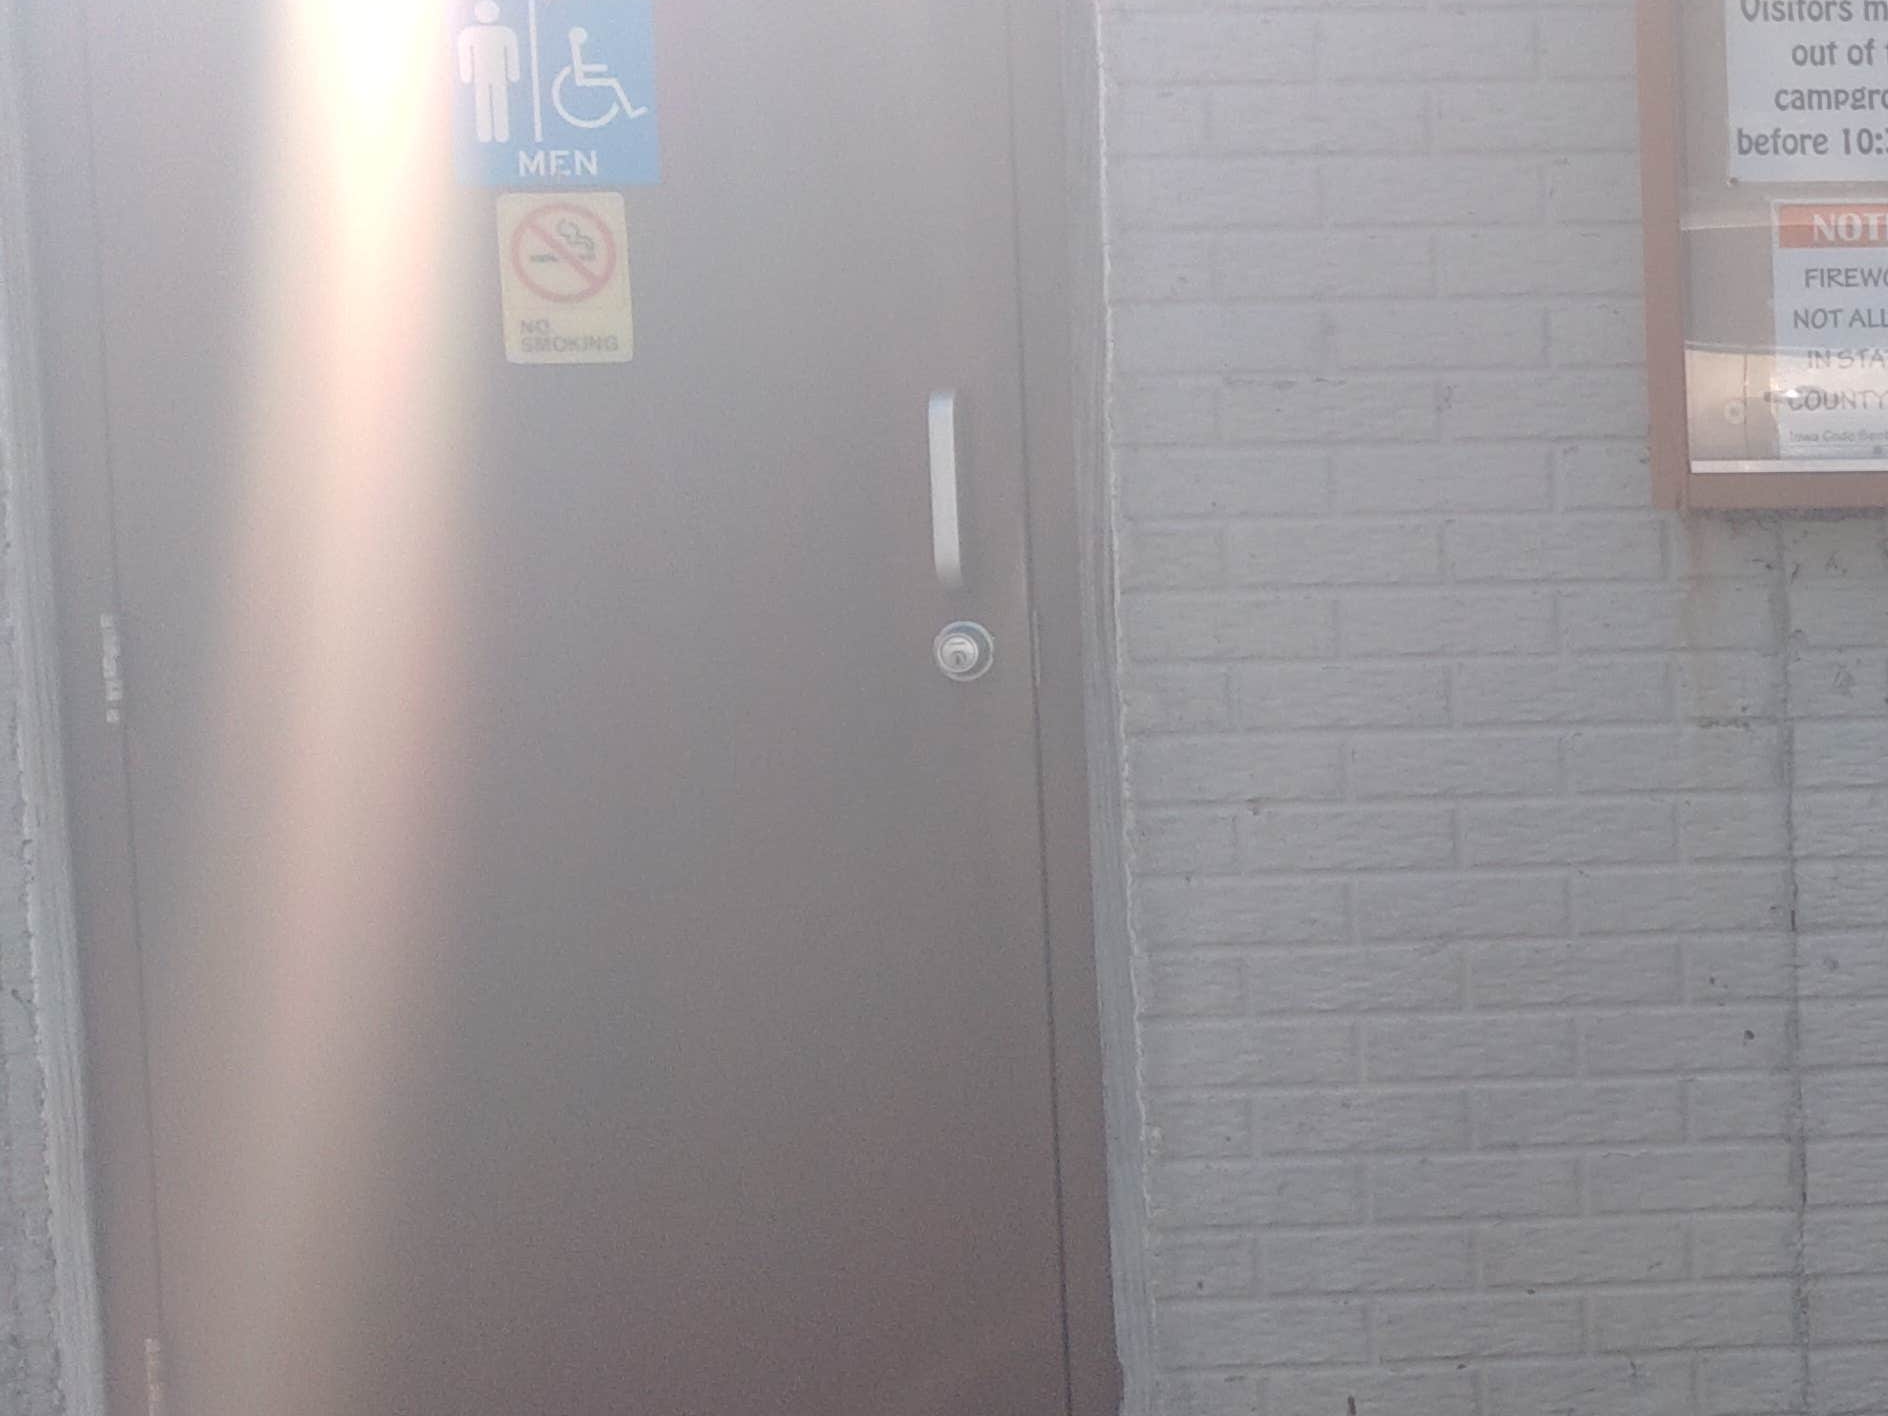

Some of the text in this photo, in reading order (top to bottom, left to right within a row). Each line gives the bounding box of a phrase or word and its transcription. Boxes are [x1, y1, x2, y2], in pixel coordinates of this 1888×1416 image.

[1792, 41, 1837, 66] out
[1847, 39, 1874, 65] of
[1737, 129, 1828, 155] before
[518, 149, 599, 176] MEN
[521, 320, 550, 336] NO
[1793, 308, 1844, 329] NOT
[520, 335, 618, 353] SMOKING
[1808, 349, 1830, 369] IN
[1788, 389, 1888, 411] COUNTY
